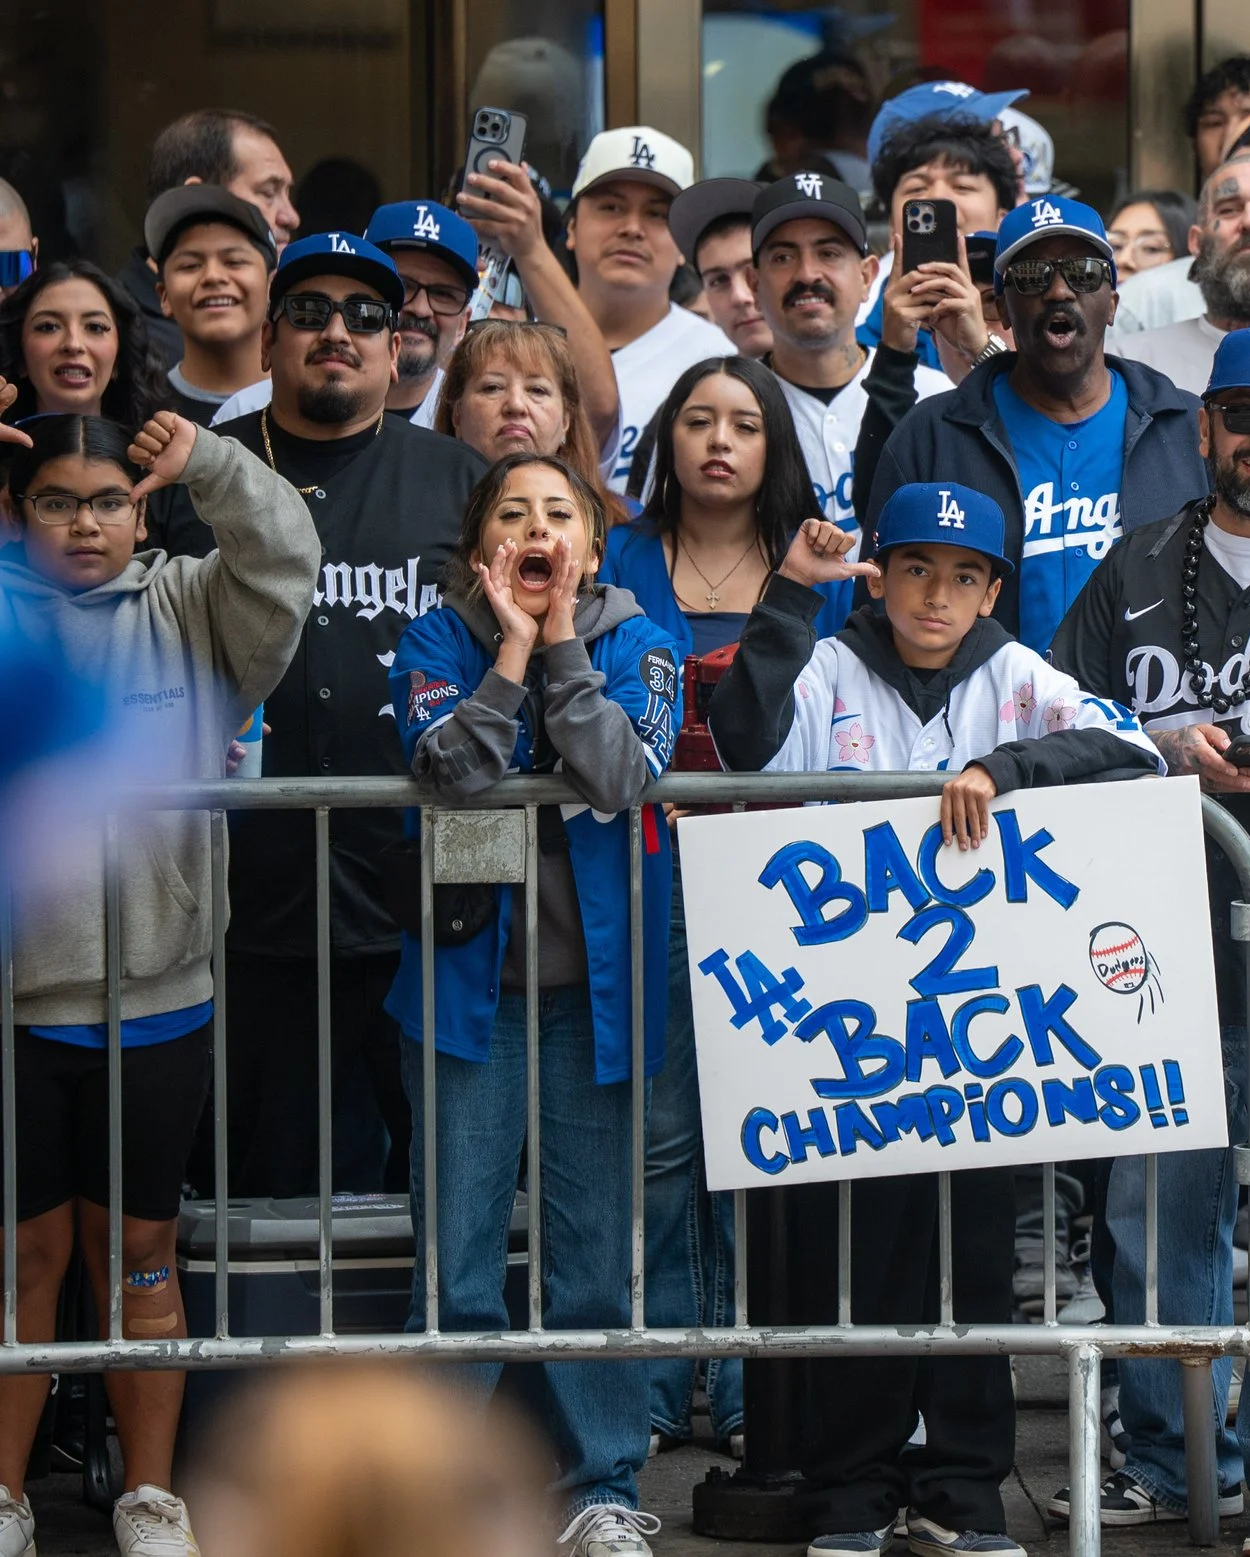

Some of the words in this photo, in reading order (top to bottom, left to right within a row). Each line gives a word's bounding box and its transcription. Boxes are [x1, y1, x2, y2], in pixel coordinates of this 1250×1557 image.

[630, 136, 655, 168] LA
[413, 205, 440, 241] LA
[1031, 199, 1064, 228] LA
[328, 233, 356, 255] LA
[936, 490, 965, 529] LA
[312, 555, 444, 622] ngele
[647, 654, 676, 675] FERNANDO
[122, 686, 185, 706] ESSENTIALS
[649, 666, 675, 702] 34
[414, 704, 431, 721] LA
[757, 808, 1082, 948] BACK
[895, 902, 1000, 998] 2
[697, 948, 813, 1047] LA
[792, 983, 1103, 1100] BACK
